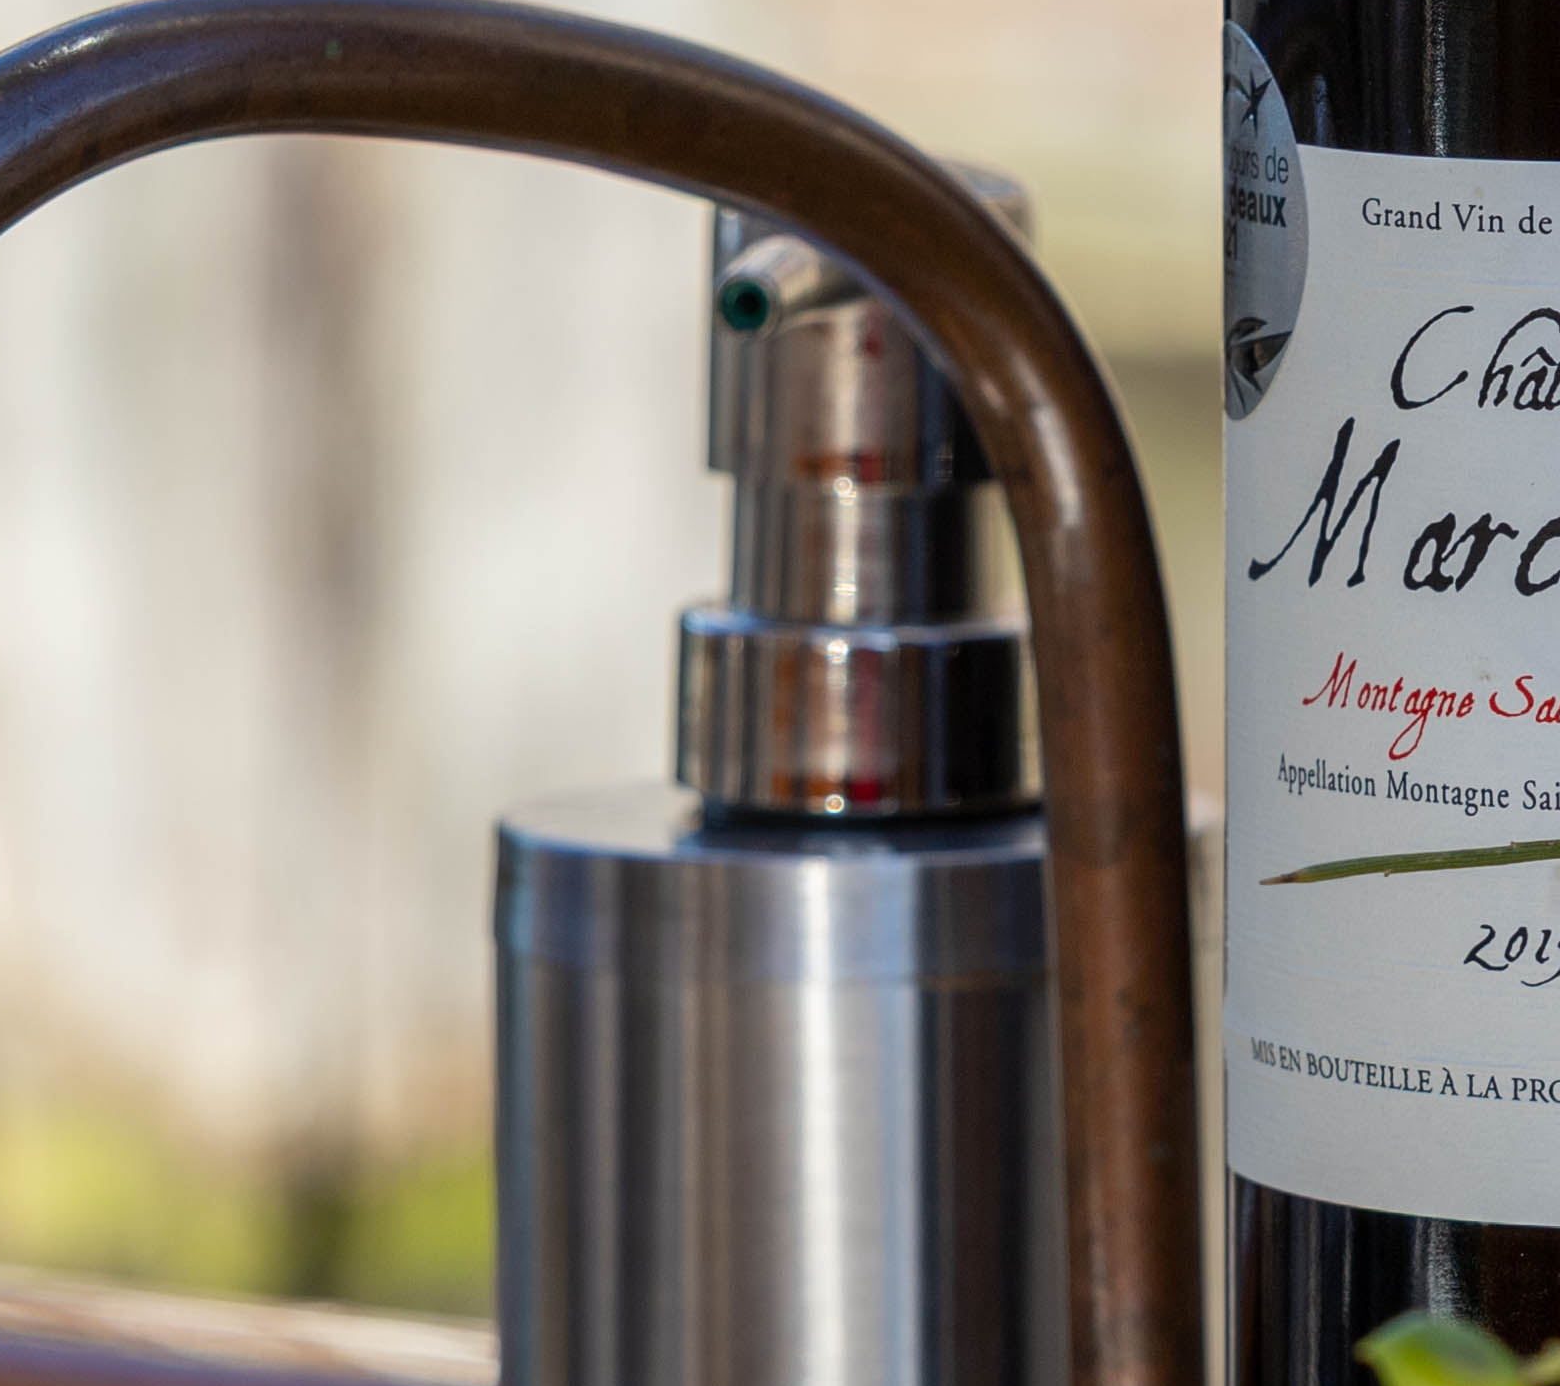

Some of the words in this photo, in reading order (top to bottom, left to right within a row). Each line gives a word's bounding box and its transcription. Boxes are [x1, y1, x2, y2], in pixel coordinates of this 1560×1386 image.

[1264, 146, 1289, 184] de
[1361, 197, 1443, 231] Grand
[1451, 203, 1505, 234] Vin
[1518, 204, 1553, 235] de
[1303, 652, 1474, 761] Montagne
[1277, 753, 1377, 797] Appellation
[1385, 769, 1510, 817] Montagne
[1251, 1037, 1276, 1067] MIS
[1278, 1045, 1302, 1073] EN
[1305, 1052, 1433, 1094] BOUTEILLE
[1439, 1066, 1459, 1097] À
[1466, 1073, 1503, 1100] LA
